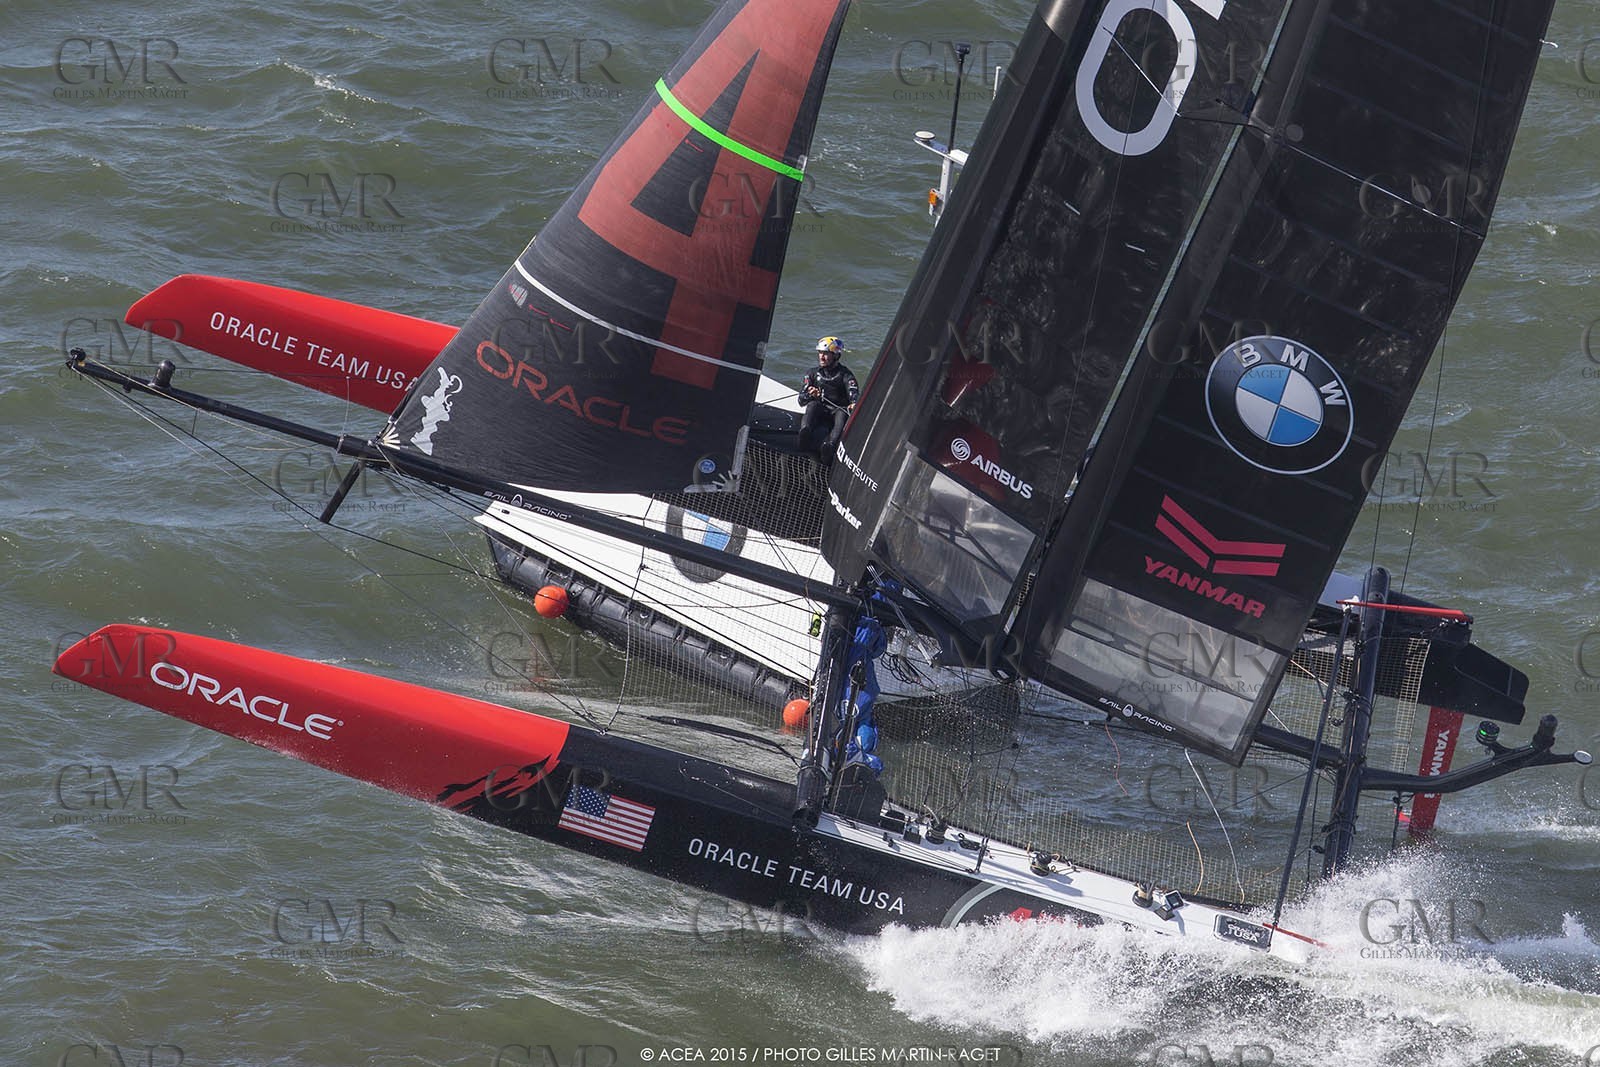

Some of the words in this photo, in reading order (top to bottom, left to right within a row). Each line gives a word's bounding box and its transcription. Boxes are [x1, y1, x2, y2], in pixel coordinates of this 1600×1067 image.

[578, 0, 841, 390] 4
[210, 311, 297, 355] ORACLE
[306, 341, 370, 379] TEAM
[1232, 343, 1347, 408] BMW
[475, 340, 692, 446] ORACLE
[843, 454, 879, 492] NETSUITE
[970, 454, 1033, 500] AIRBUS
[522, 502, 568, 520] RACING
[828, 487, 862, 530] Parker
[1143, 555, 1266, 620] YANMAR
[150, 662, 337, 740] ORACLE
[1133, 711, 1173, 732] RACING
[1423, 729, 1450, 799] YANM
[687, 837, 777, 878] ORACLE
[788, 865, 853, 900] TEAM
[858, 887, 905, 916] USA
